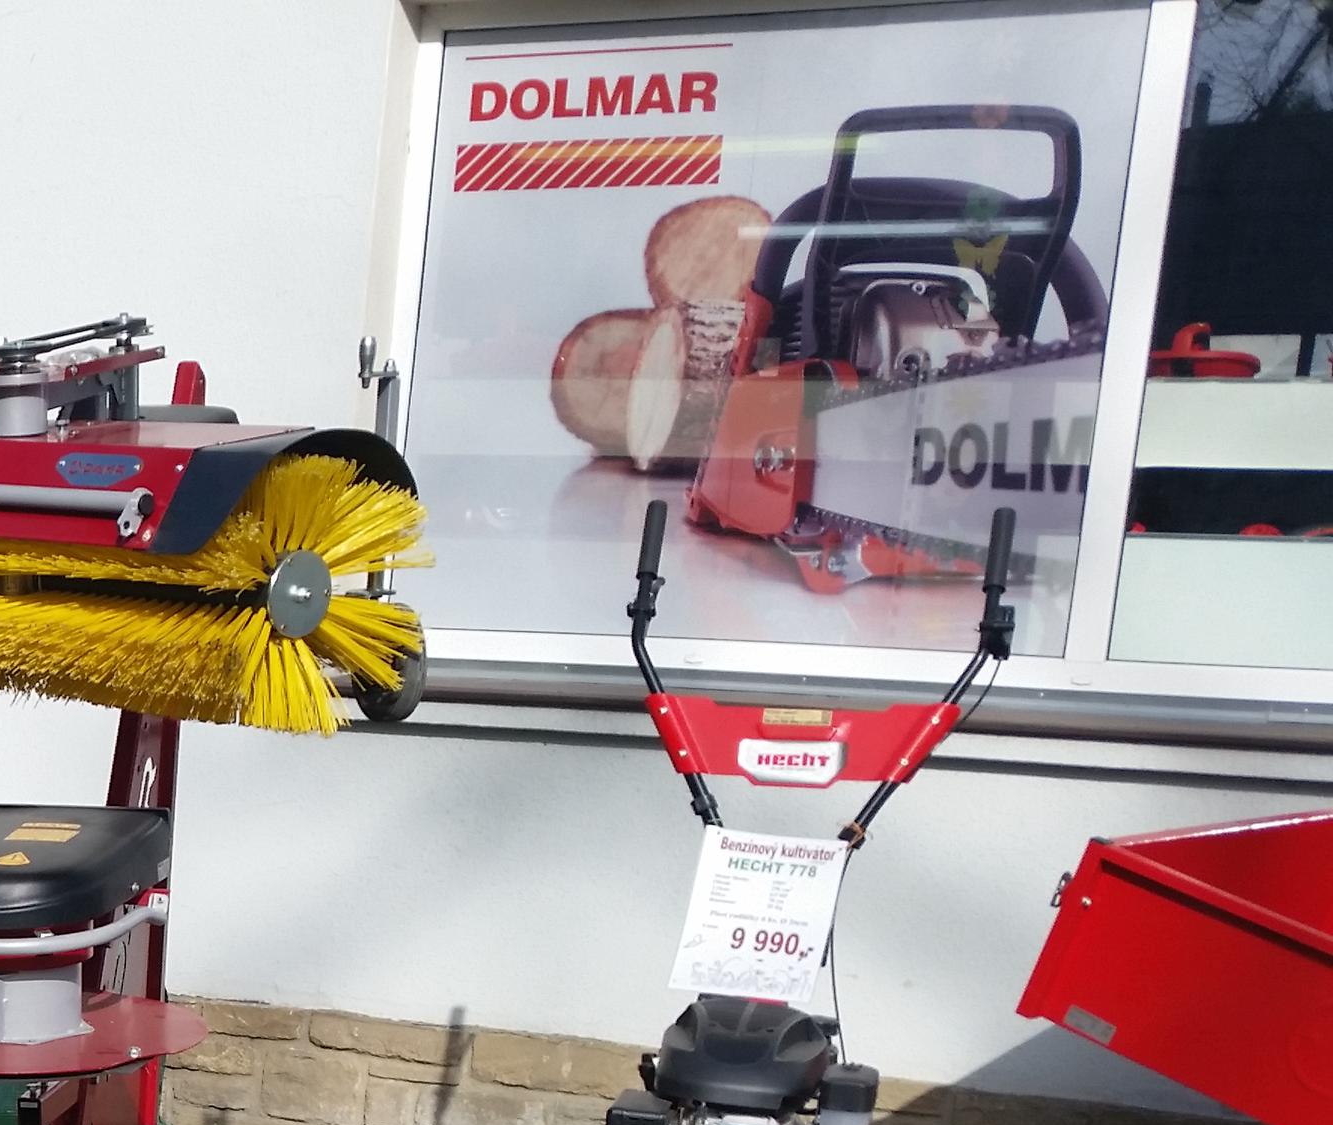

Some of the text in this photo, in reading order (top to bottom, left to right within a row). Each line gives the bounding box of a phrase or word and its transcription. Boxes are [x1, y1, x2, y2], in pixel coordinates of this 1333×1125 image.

[469, 71, 719, 122] DOLMAR
[727, 857, 818, 878] HECHT 778
[730, 927, 746, 950] 9
